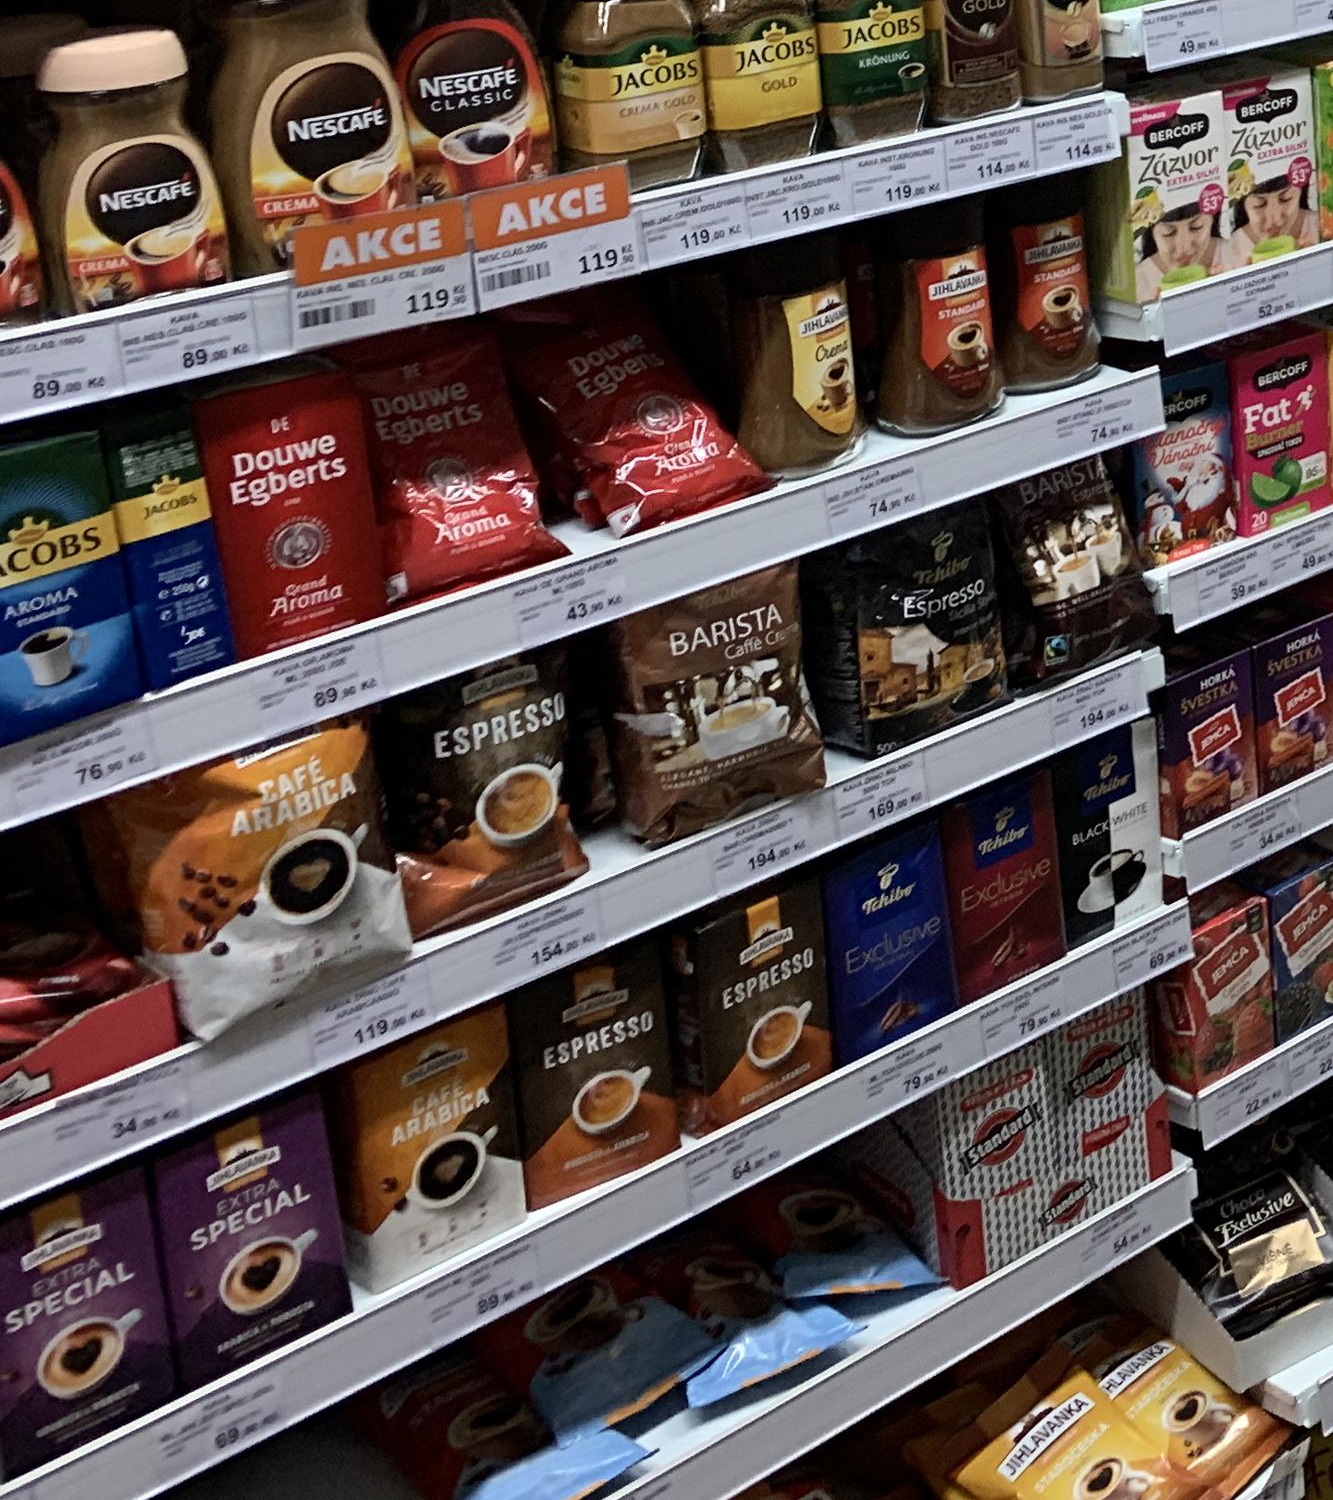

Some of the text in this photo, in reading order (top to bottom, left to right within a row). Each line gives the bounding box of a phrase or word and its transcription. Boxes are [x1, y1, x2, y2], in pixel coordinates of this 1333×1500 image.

[841, 15, 920, 49] JACOBS
[735, 37, 814, 72] JACOBS
[419, 59, 518, 98] NESCAFÉ
[611, 58, 698, 96] JACOBS
[762, 77, 797, 94] GOLD
[430, 88, 513, 112] CLASSIC
[263, 197, 319, 214] CREMA
[496, 183, 607, 235] AKCE
[321, 218, 443, 271] AKCE
[79, 257, 128, 272] CREMA
[1034, 264, 1082, 283] STANDARD
[406, 289, 449, 314] 119
[1257, 360, 1309, 386] BERCOFF
[370, 382, 469, 417] Douwe
[1243, 400, 1291, 434] Fat
[375, 402, 483, 446] Egberts
[232, 433, 337, 478] Douwe
[230, 458, 347, 507] Egberts
[1019, 461, 1109, 504] BARISTA
[434, 509, 511, 545] Aroma
[1252, 510, 1267, 528] 20
[4, 585, 78, 620] AROMA
[271, 583, 344, 616] Aroma
[285, 575, 328, 596] Grand
[903, 579, 985, 619] Espresso
[669, 604, 784, 657] BARISTA
[1286, 630, 1321, 654] HORKÁ
[1200, 665, 1235, 691] HORKÁ
[1267, 645, 1323, 677] ŠVESTKA
[433, 691, 565, 759] ESPRESSO
[259, 757, 326, 805] CAFÉ
[231, 778, 357, 837] ARABICA
[1072, 801, 1148, 846] BLACK WHITE
[978, 823, 1029, 855] Tchibo
[960, 857, 1052, 911] Exclusive
[846, 914, 942, 974] Exclusive
[722, 947, 815, 1009] ESPRESSO
[390, 1088, 490, 1148] ARABICA
[967, 1108, 1034, 1164] Standard
[190, 1184, 311, 1252] SPECIAL
[1043, 1179, 1094, 1224] Standard
[4, 1263, 135, 1334] SPECIAL
[1005, 1395, 1089, 1477] JIHLAVANKA
